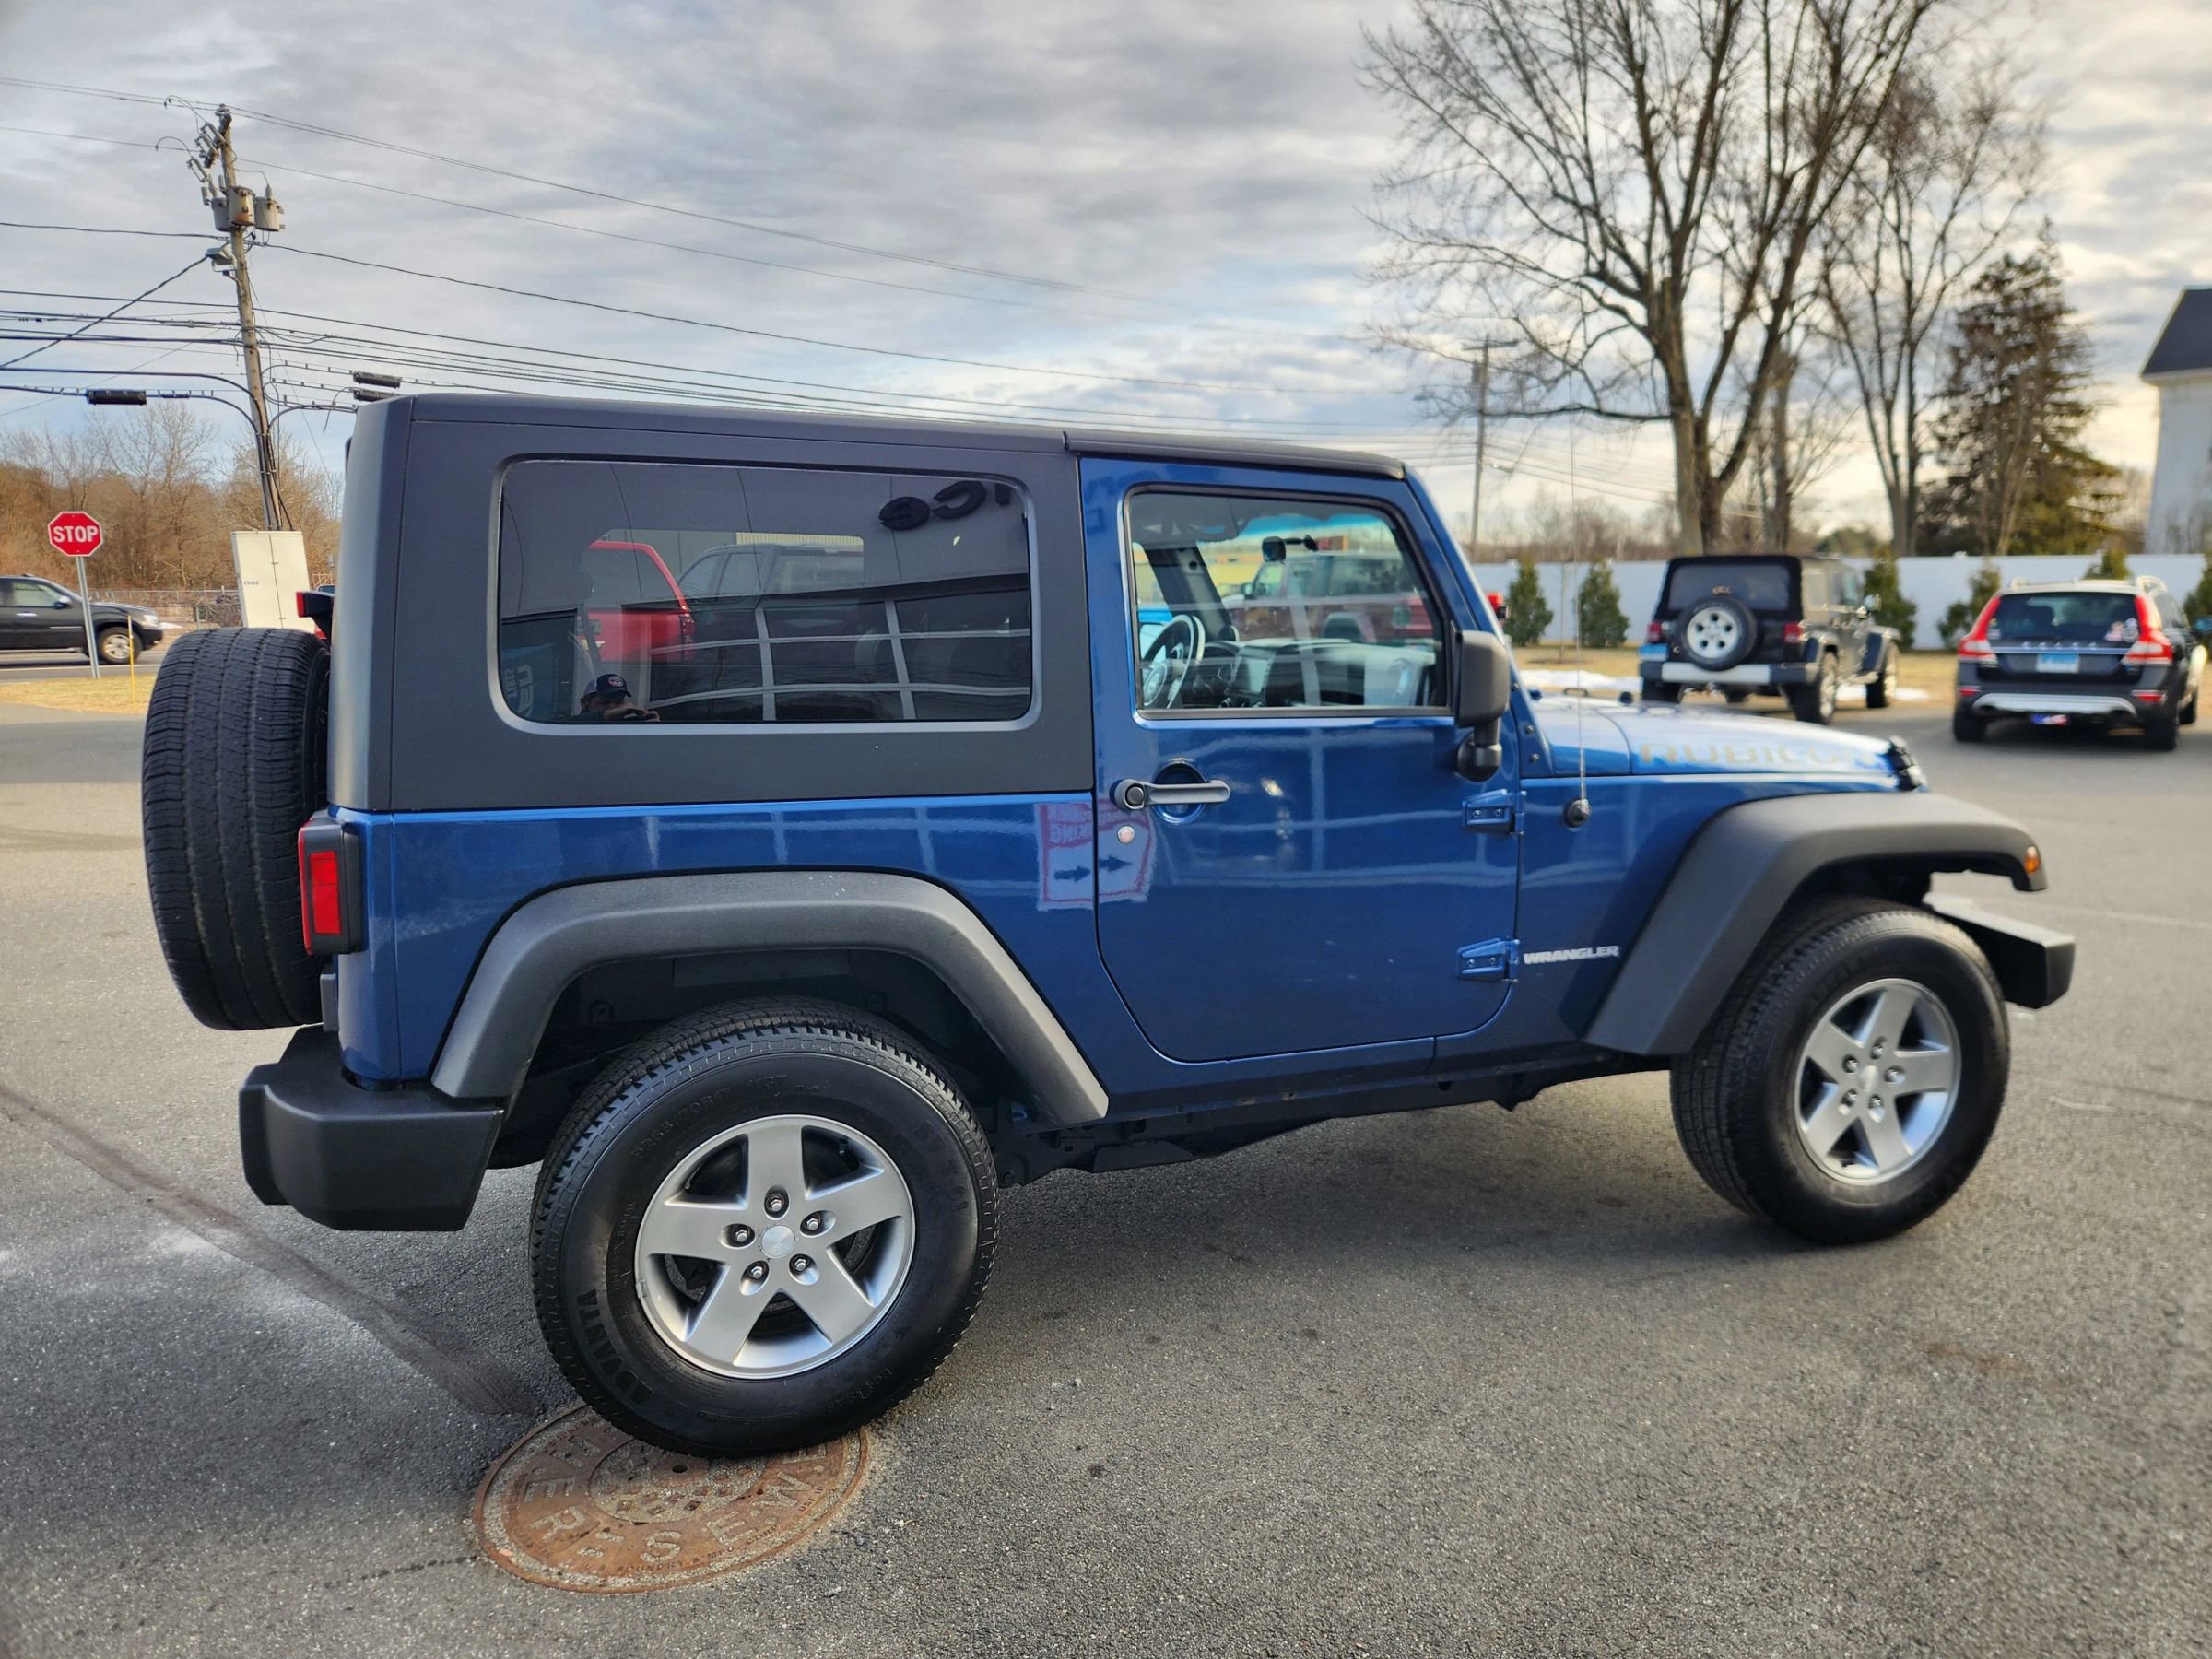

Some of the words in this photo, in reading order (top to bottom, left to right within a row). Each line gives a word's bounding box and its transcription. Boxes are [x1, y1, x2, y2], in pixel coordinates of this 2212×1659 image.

[53, 525, 99, 543] STOP
[1523, 945, 1620, 965] WRANGLER
[576, 1288, 654, 1404] ADVANTA
